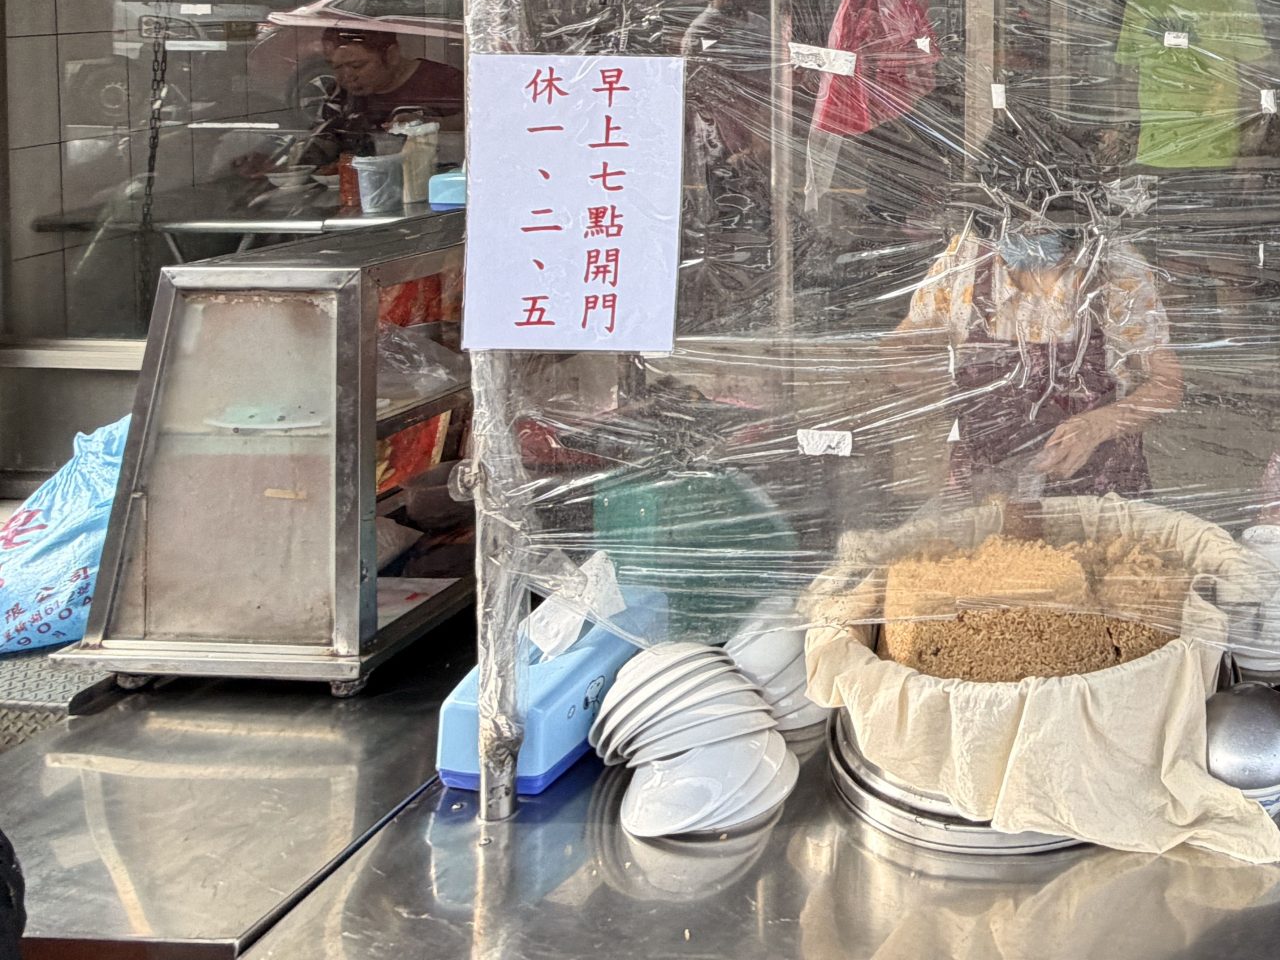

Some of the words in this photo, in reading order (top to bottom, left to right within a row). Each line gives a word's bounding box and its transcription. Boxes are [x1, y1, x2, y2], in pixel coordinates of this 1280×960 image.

[514, 66, 570, 327] 休一、二、五
[581, 68, 630, 333] 早上七點開門
